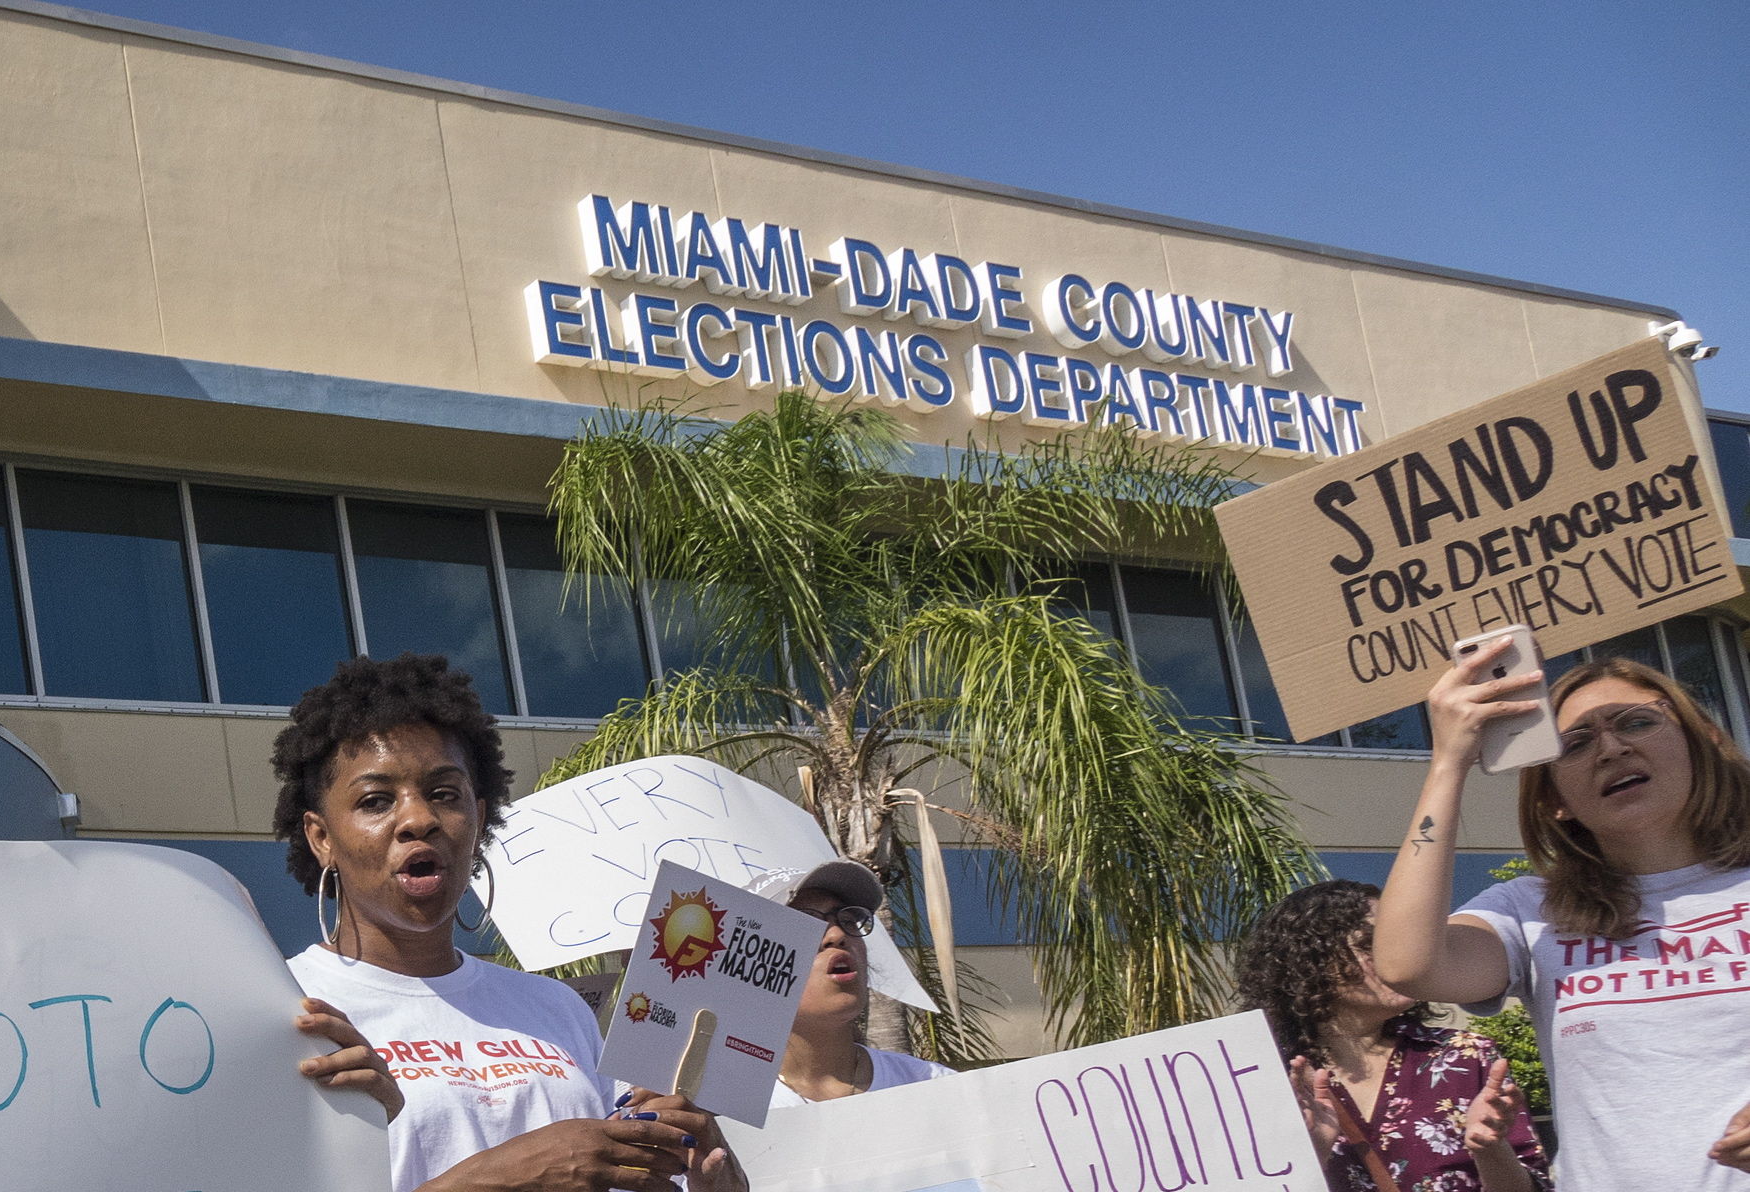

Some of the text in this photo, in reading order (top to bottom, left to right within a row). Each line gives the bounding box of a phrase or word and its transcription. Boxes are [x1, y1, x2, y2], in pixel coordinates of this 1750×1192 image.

[586, 193, 1294, 374] MIAMI-DADE COUNTY
[539, 280, 1364, 455] ELECTIONS DEPARTMENT
[1313, 368, 1662, 575] STAND UP
[1340, 454, 1703, 627] FOR DEMOCRACY
[1346, 513, 1722, 684] COUNT EVERY VOTE
[495, 764, 730, 866] EVERY
[591, 836, 768, 880] VOTE
[718, 950, 798, 997] MAJORITY
[728, 927, 797, 974] FLORIDA
[1556, 937, 1641, 967] THE
[1555, 972, 1629, 1000] NOT
[1638, 967, 1716, 990] THE
[388, 1061, 569, 1082] FOR GOVERNOR
[476, 1039, 578, 1067] GILLU
